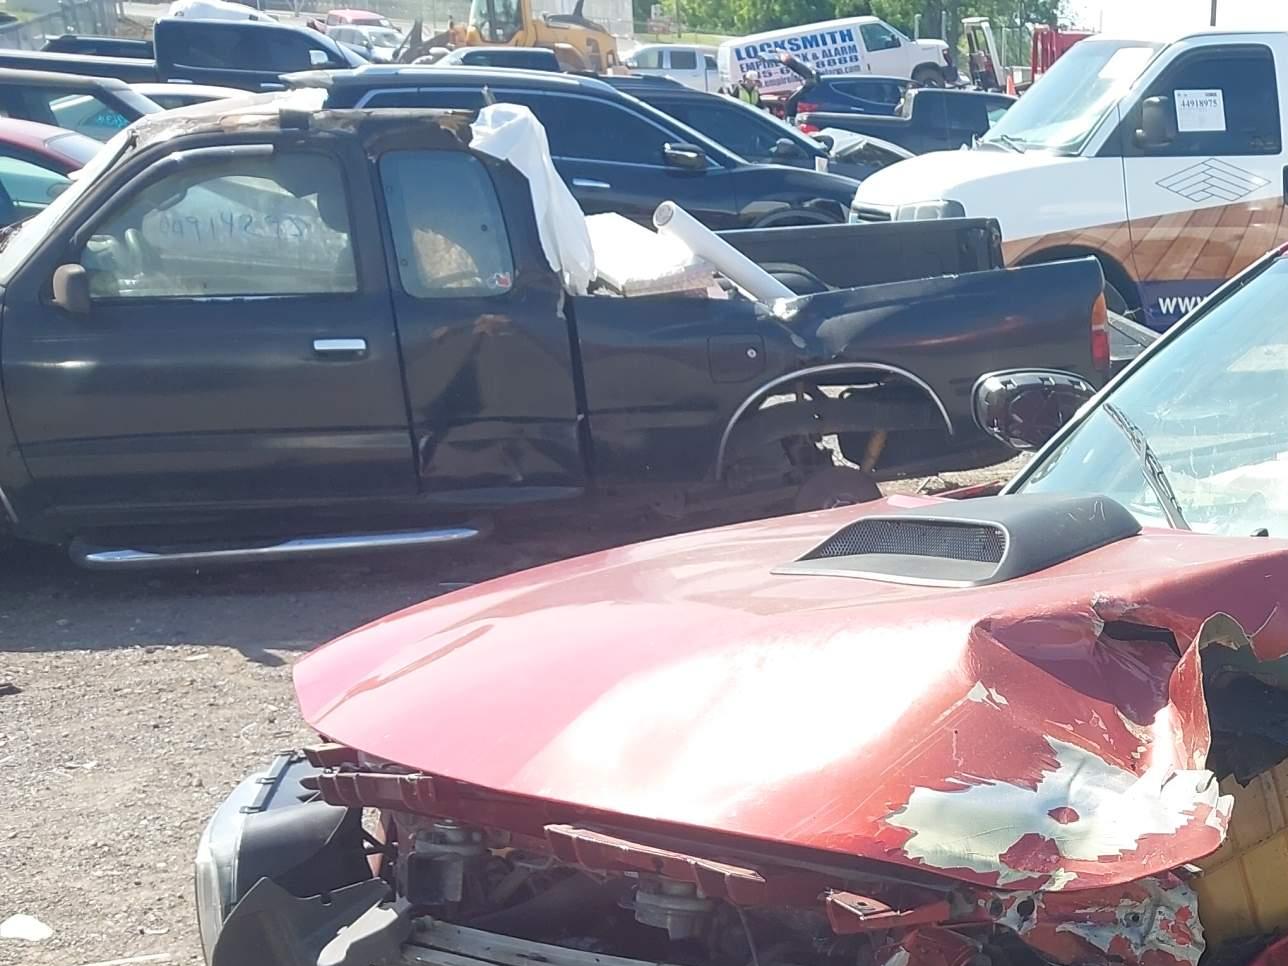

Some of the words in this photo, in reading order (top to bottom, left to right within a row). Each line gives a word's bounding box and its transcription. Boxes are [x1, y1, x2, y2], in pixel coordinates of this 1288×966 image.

[735, 29, 855, 62] LOCKSMITH
[822, 45, 858, 59] ALARM
[1181, 99, 1218, 108] 44918975
